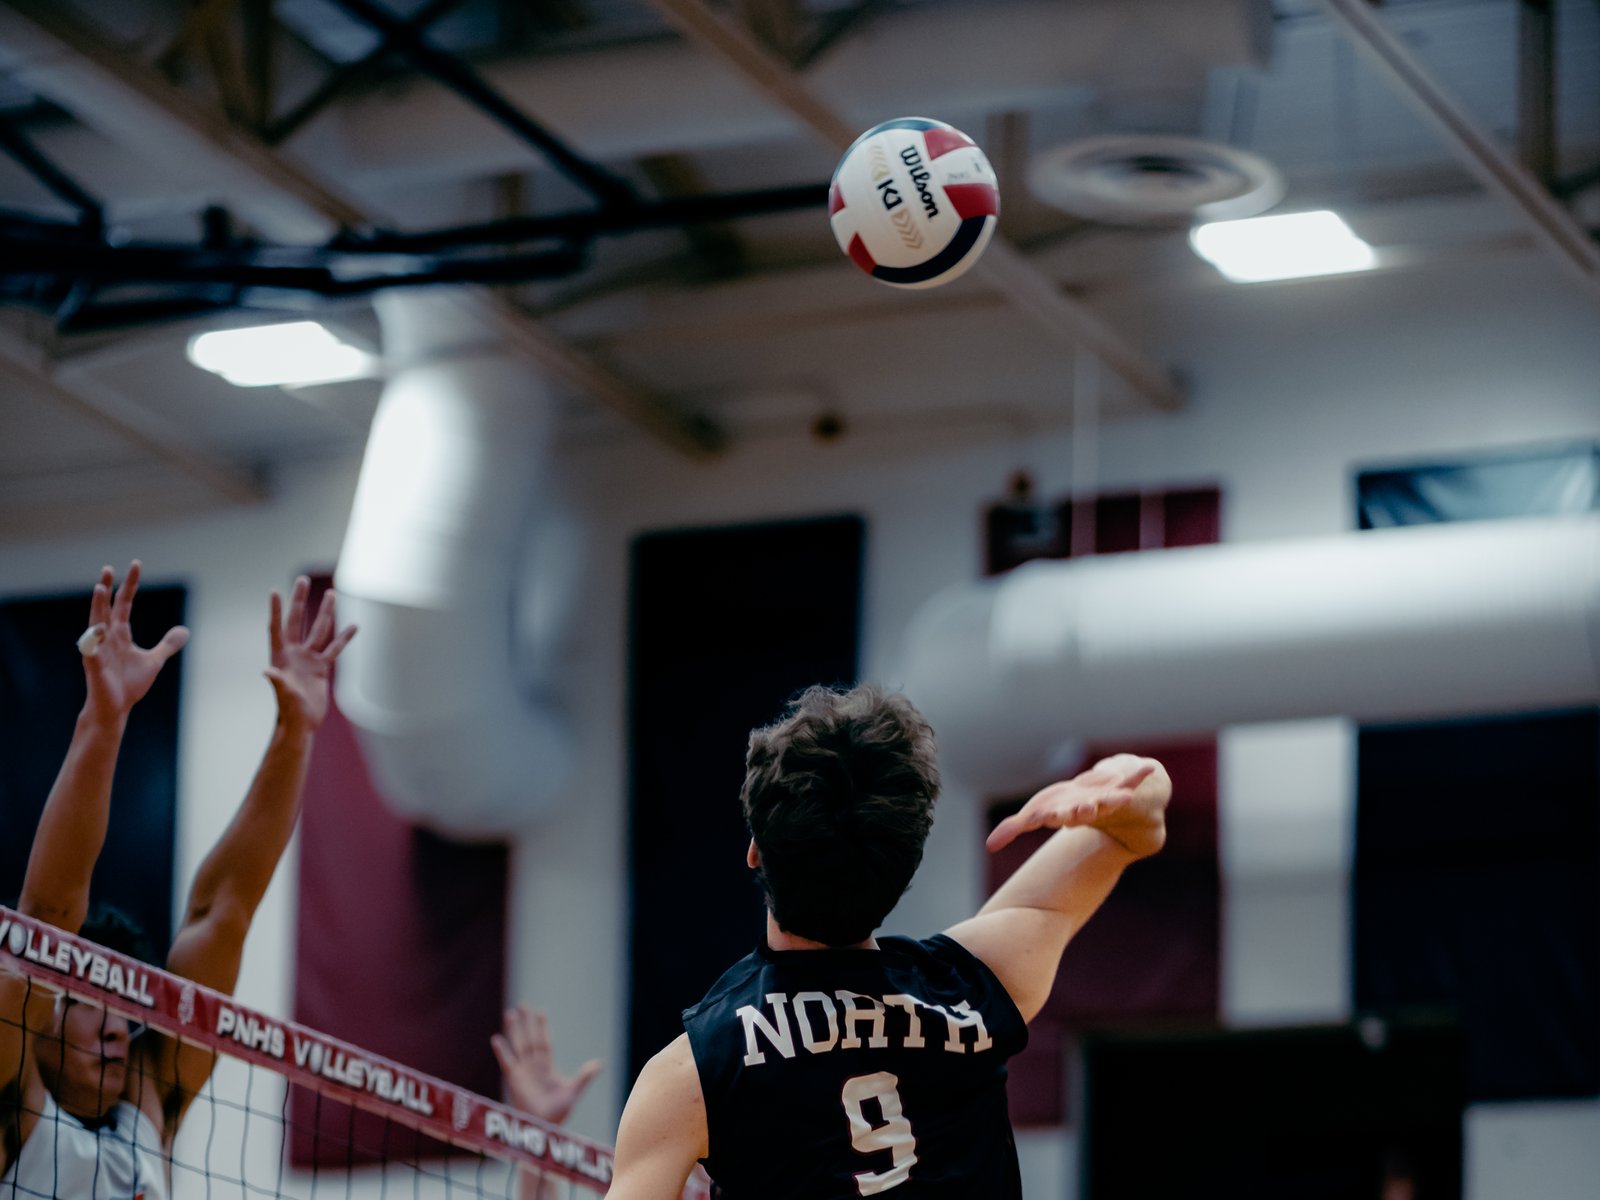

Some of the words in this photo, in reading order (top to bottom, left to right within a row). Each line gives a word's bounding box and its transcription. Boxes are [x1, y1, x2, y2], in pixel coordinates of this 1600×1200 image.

[900, 144, 939, 221] Wilson
[216, 1006, 286, 1058] PNHS
[293, 1035, 434, 1116] VOLLEYBALL
[736, 989, 993, 1066] NORTH
[841, 1070, 918, 1197] 9
